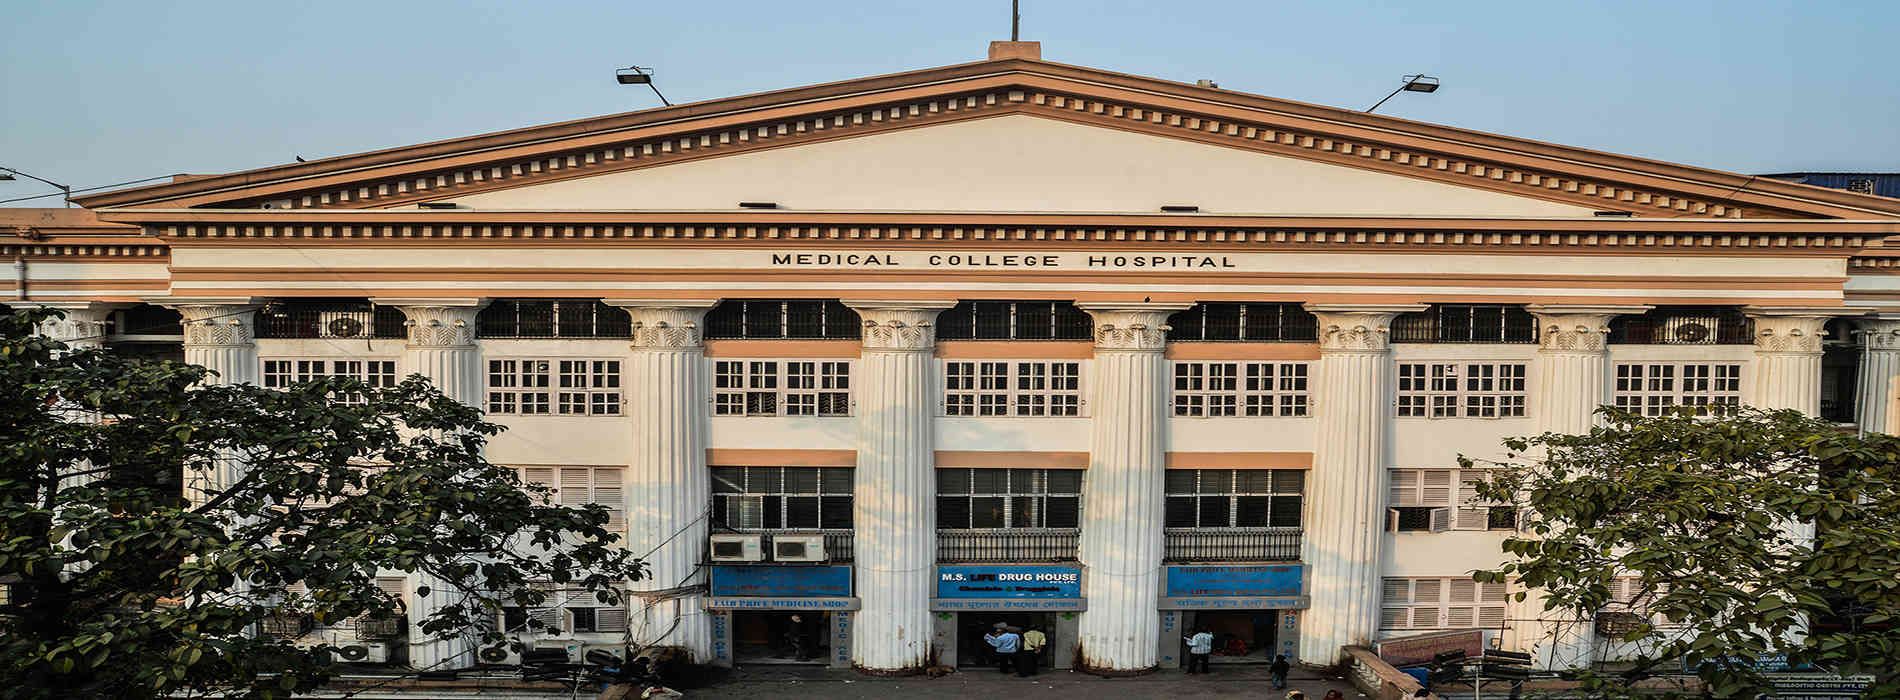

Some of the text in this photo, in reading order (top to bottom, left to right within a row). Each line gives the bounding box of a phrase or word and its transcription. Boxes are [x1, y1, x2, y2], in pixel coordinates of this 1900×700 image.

[772, 254, 1236, 268] MEDICAL COLLEGE HOSPITAL
[942, 573, 1077, 582] M.S. LIFE DRUG HOUSE
